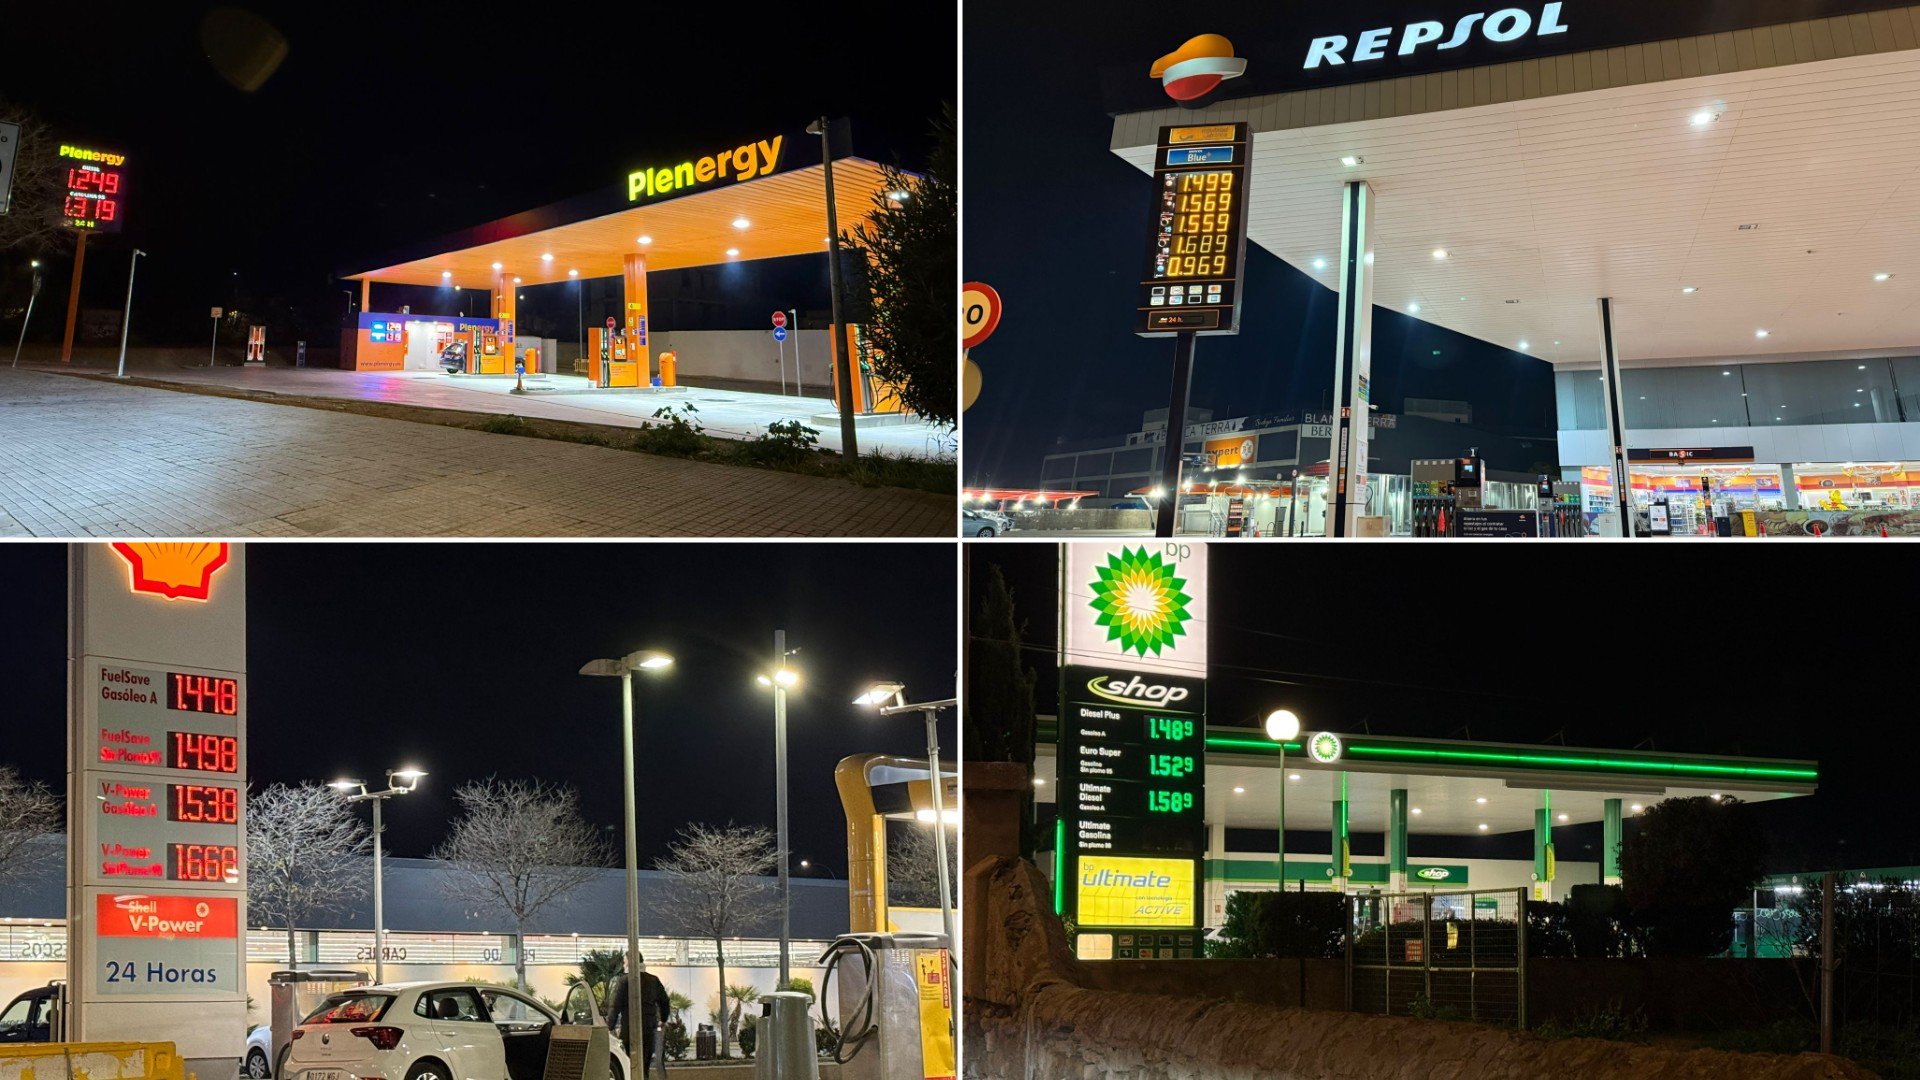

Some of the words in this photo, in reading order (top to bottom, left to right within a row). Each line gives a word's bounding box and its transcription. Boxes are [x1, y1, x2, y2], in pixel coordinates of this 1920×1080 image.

[1303, 1, 1569, 69] REPSOL
[60, 145, 125, 166] Plenergy
[628, 134, 783, 201] Plenergy
[67, 168, 119, 194] 1.249
[1183, 172, 1233, 192] 1.499
[64, 196, 116, 221] 1.319
[1181, 193, 1232, 212] 1.569
[74, 219, 86, 227] 24
[1179, 213, 1229, 233] 1.559
[1177, 234, 1228, 254] 1.689
[1166, 255, 1226, 277] 0.969
[1200, 420, 1231, 436] TERRA
[1367, 417, 1396, 428] ERRA
[1668, 450, 1694, 459] BASIC
[1165, 542, 1191, 562] bp
[101, 667, 151, 686] FuelSave
[101, 687, 147, 704] Gasóleo
[149, 691, 158, 705] A
[175, 674, 237, 715] 1.448
[1107, 676, 1189, 706] shop
[1080, 708, 1103, 719] Diesel
[1104, 710, 1121, 720] Plus
[101, 728, 151, 746] FuelSave
[1149, 718, 1193, 741] 1.489
[175, 733, 237, 772] 1.498
[1079, 746, 1098, 756] Euro
[1099, 747, 1122, 758] Super
[1149, 754, 1194, 778] 1.529
[101, 782, 151, 800] V-Power
[1079, 783, 1112, 793] Ultimate
[1079, 792, 1103, 802] Diesel
[175, 785, 237, 823] 1.538
[1148, 790, 1193, 813] 1.589
[1078, 820, 1111, 830] Ultimate
[1078, 830, 1112, 840] Gasolina
[101, 843, 151, 859] V-Power
[175, 844, 237, 881] 1.668
[1083, 862, 1095, 872] bp
[1082, 869, 1171, 888] ultimate
[1422, 868, 1450, 880] shop
[128, 900, 157, 913] Shell
[1134, 904, 1183, 915] ACTIVE
[129, 915, 204, 933] V-Power
[105, 960, 137, 983] 24
[147, 961, 217, 983] Horas
[941, 949, 950, 1008] ASPIRADOR
